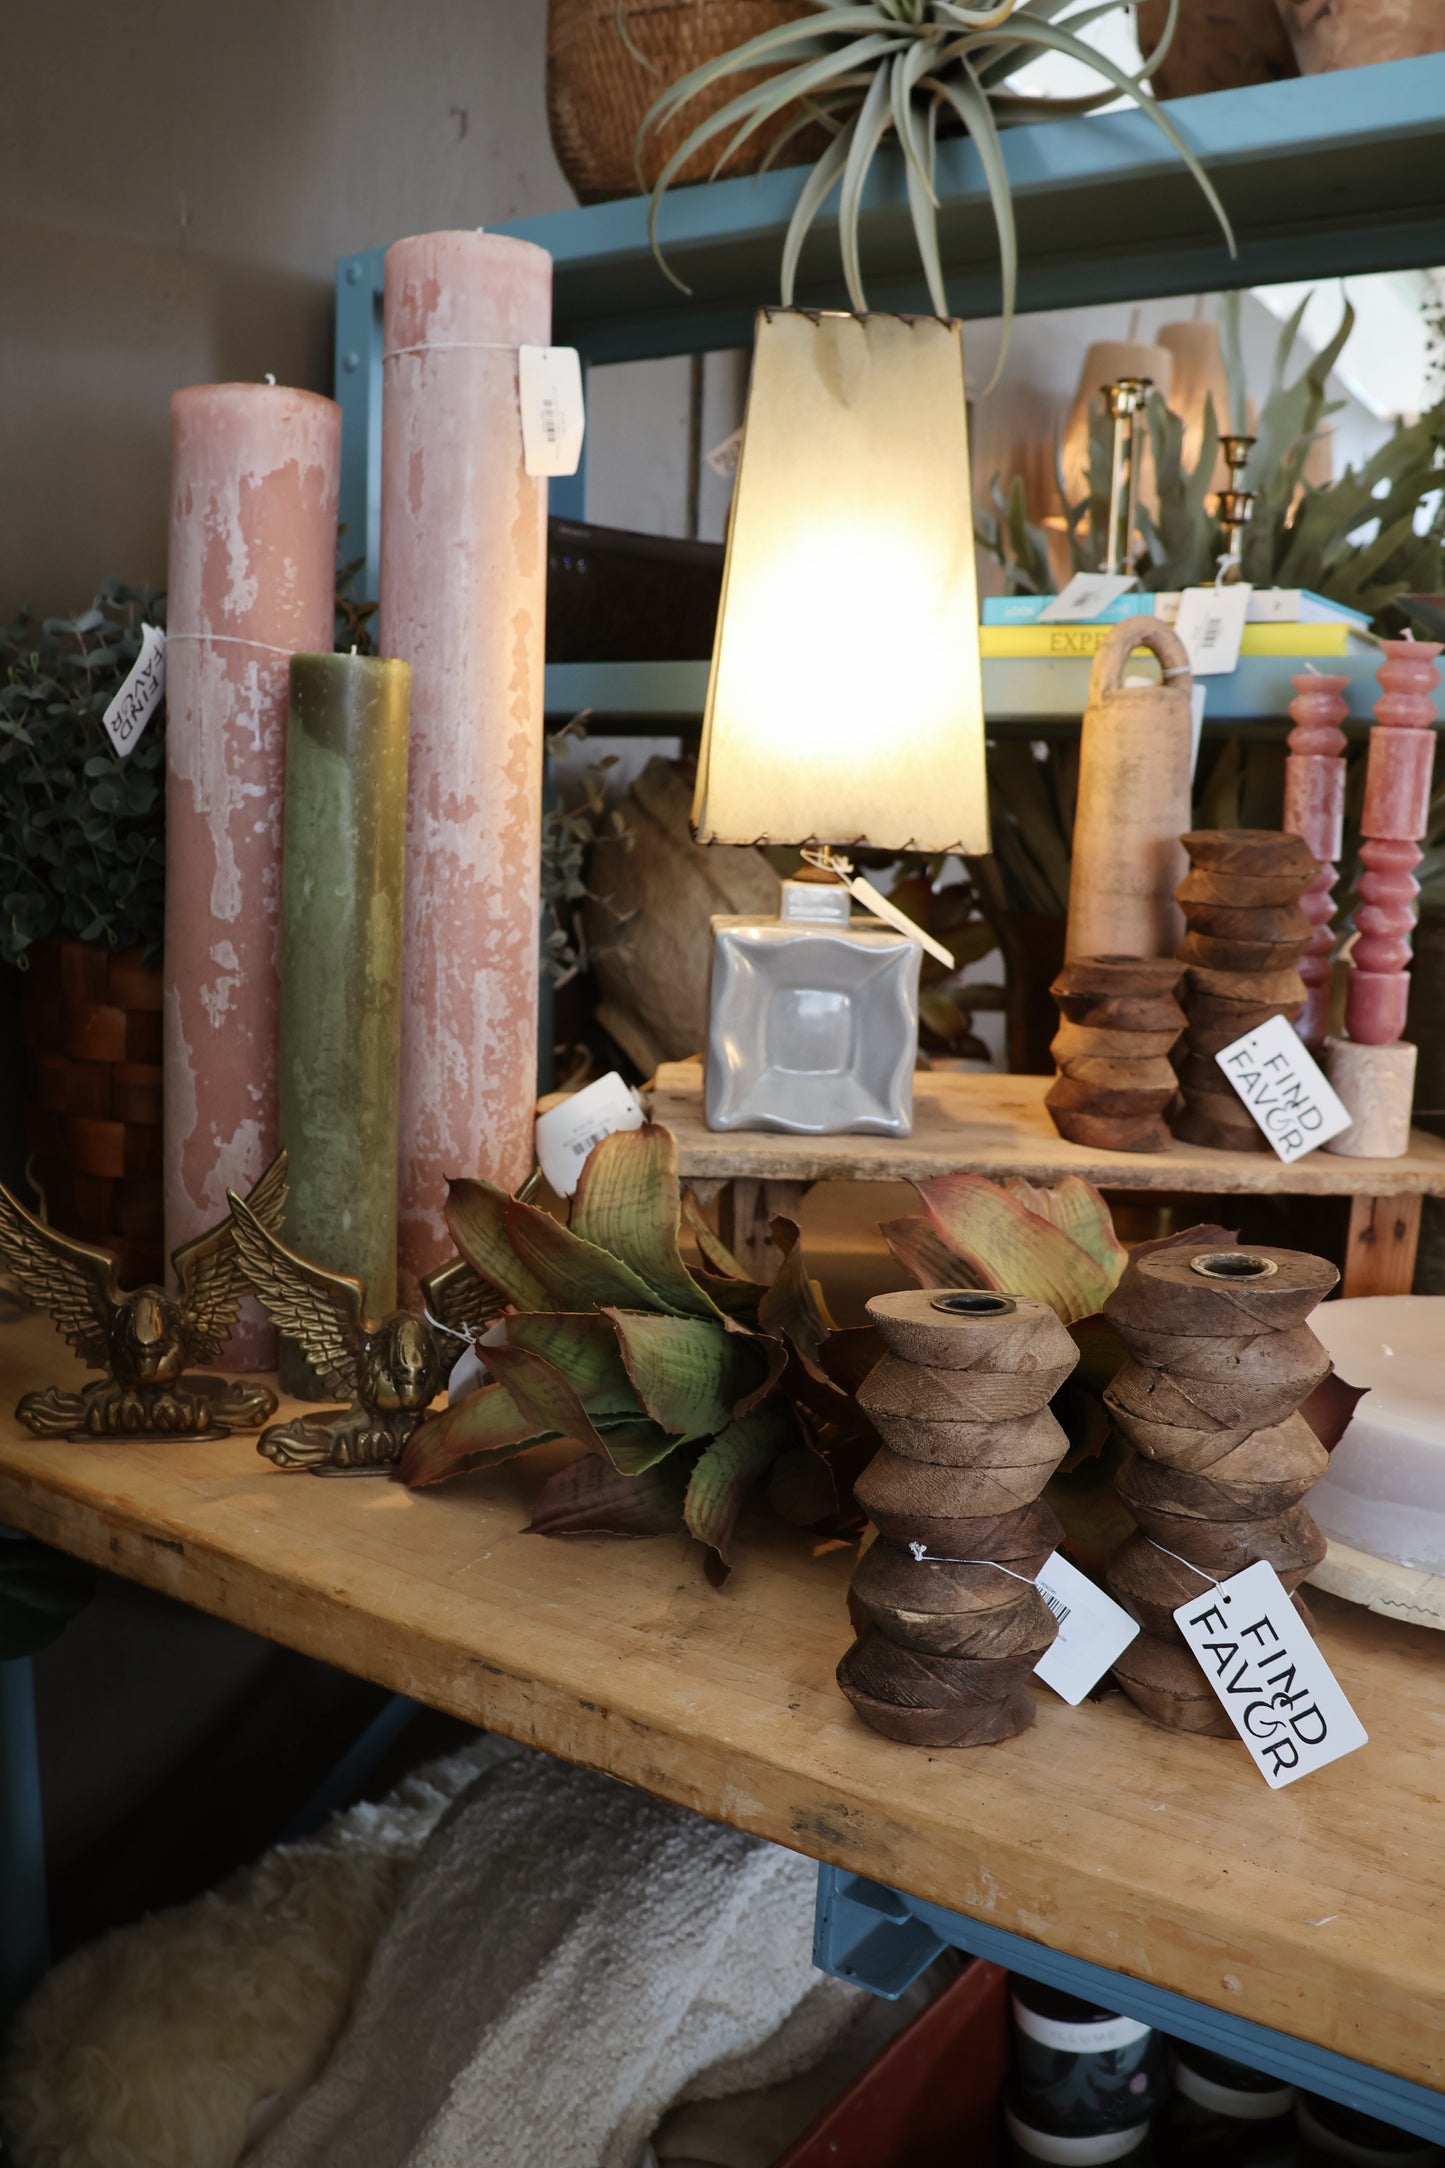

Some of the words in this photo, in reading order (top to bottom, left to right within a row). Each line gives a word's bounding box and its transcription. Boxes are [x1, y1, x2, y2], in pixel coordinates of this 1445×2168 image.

[121, 674, 160, 740] FIND
[1263, 1053, 1323, 1130] FIND
[1240, 1614, 1327, 1745] FIND
